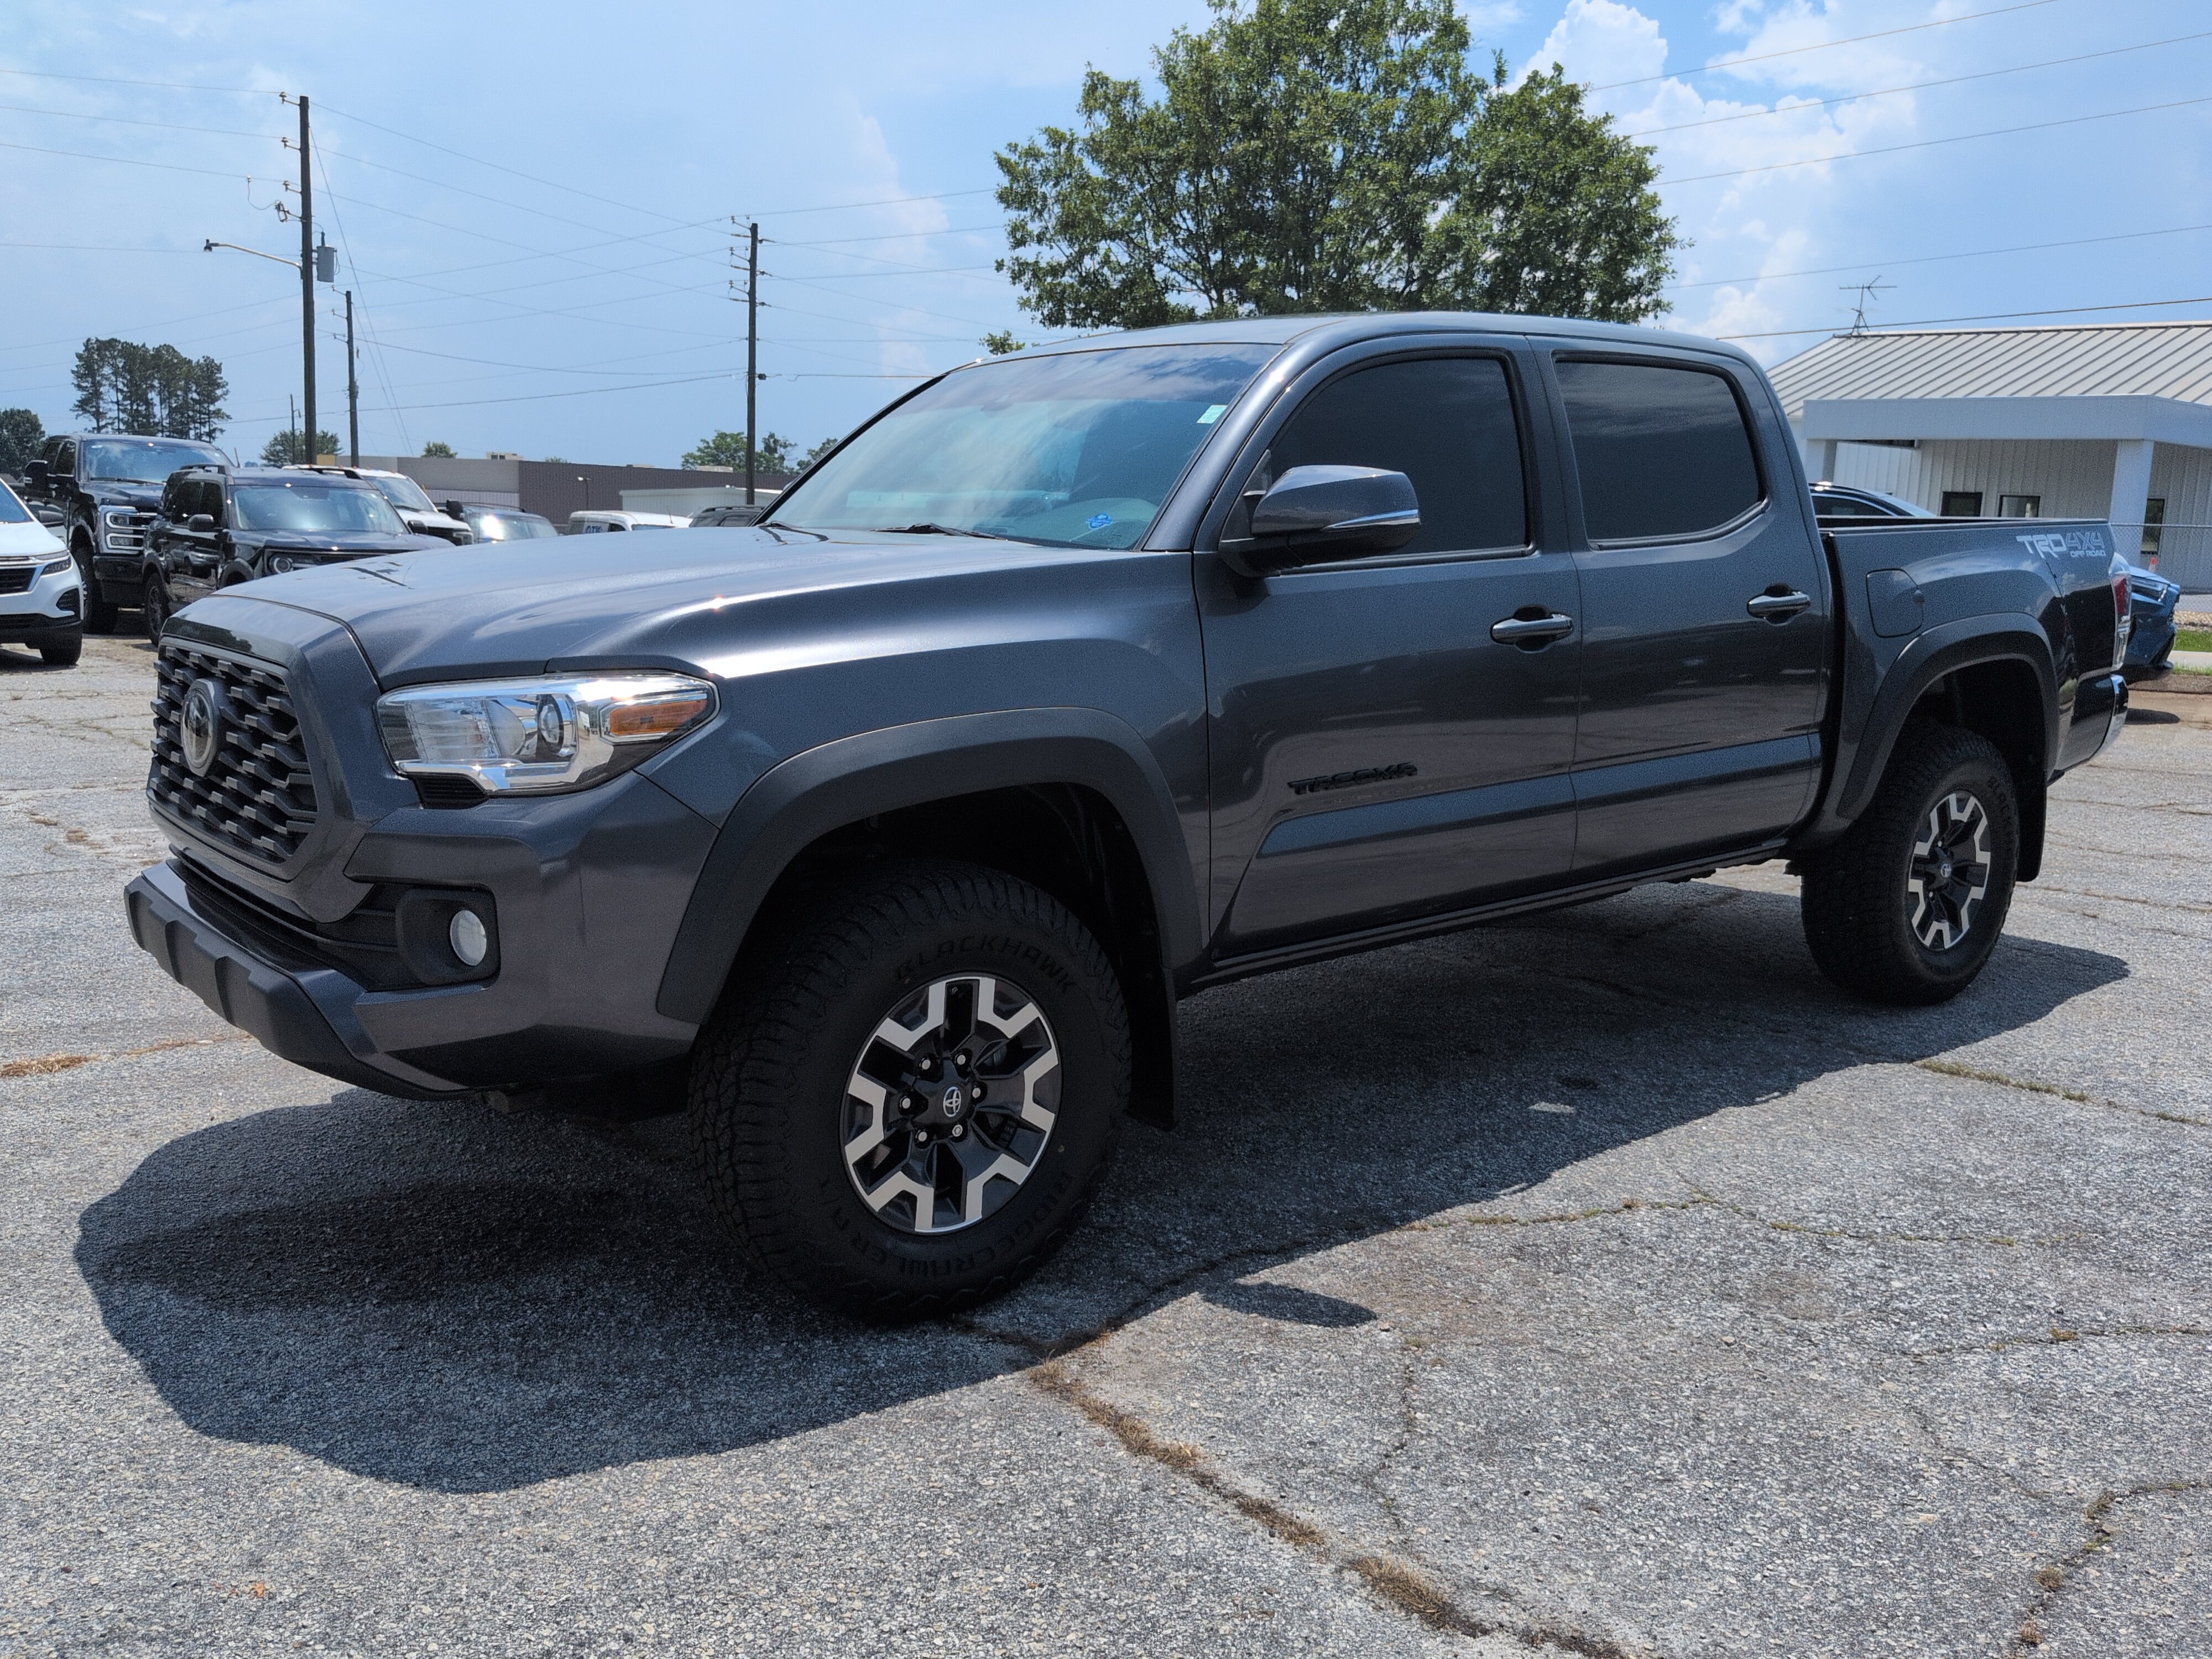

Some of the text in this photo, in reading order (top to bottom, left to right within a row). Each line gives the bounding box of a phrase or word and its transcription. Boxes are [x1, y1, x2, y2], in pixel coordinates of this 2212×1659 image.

[2016, 531, 2105, 559] TRD 4X4
[1287, 761, 1418, 795] TACOMA
[894, 935, 1077, 994] BLACKHAWK
